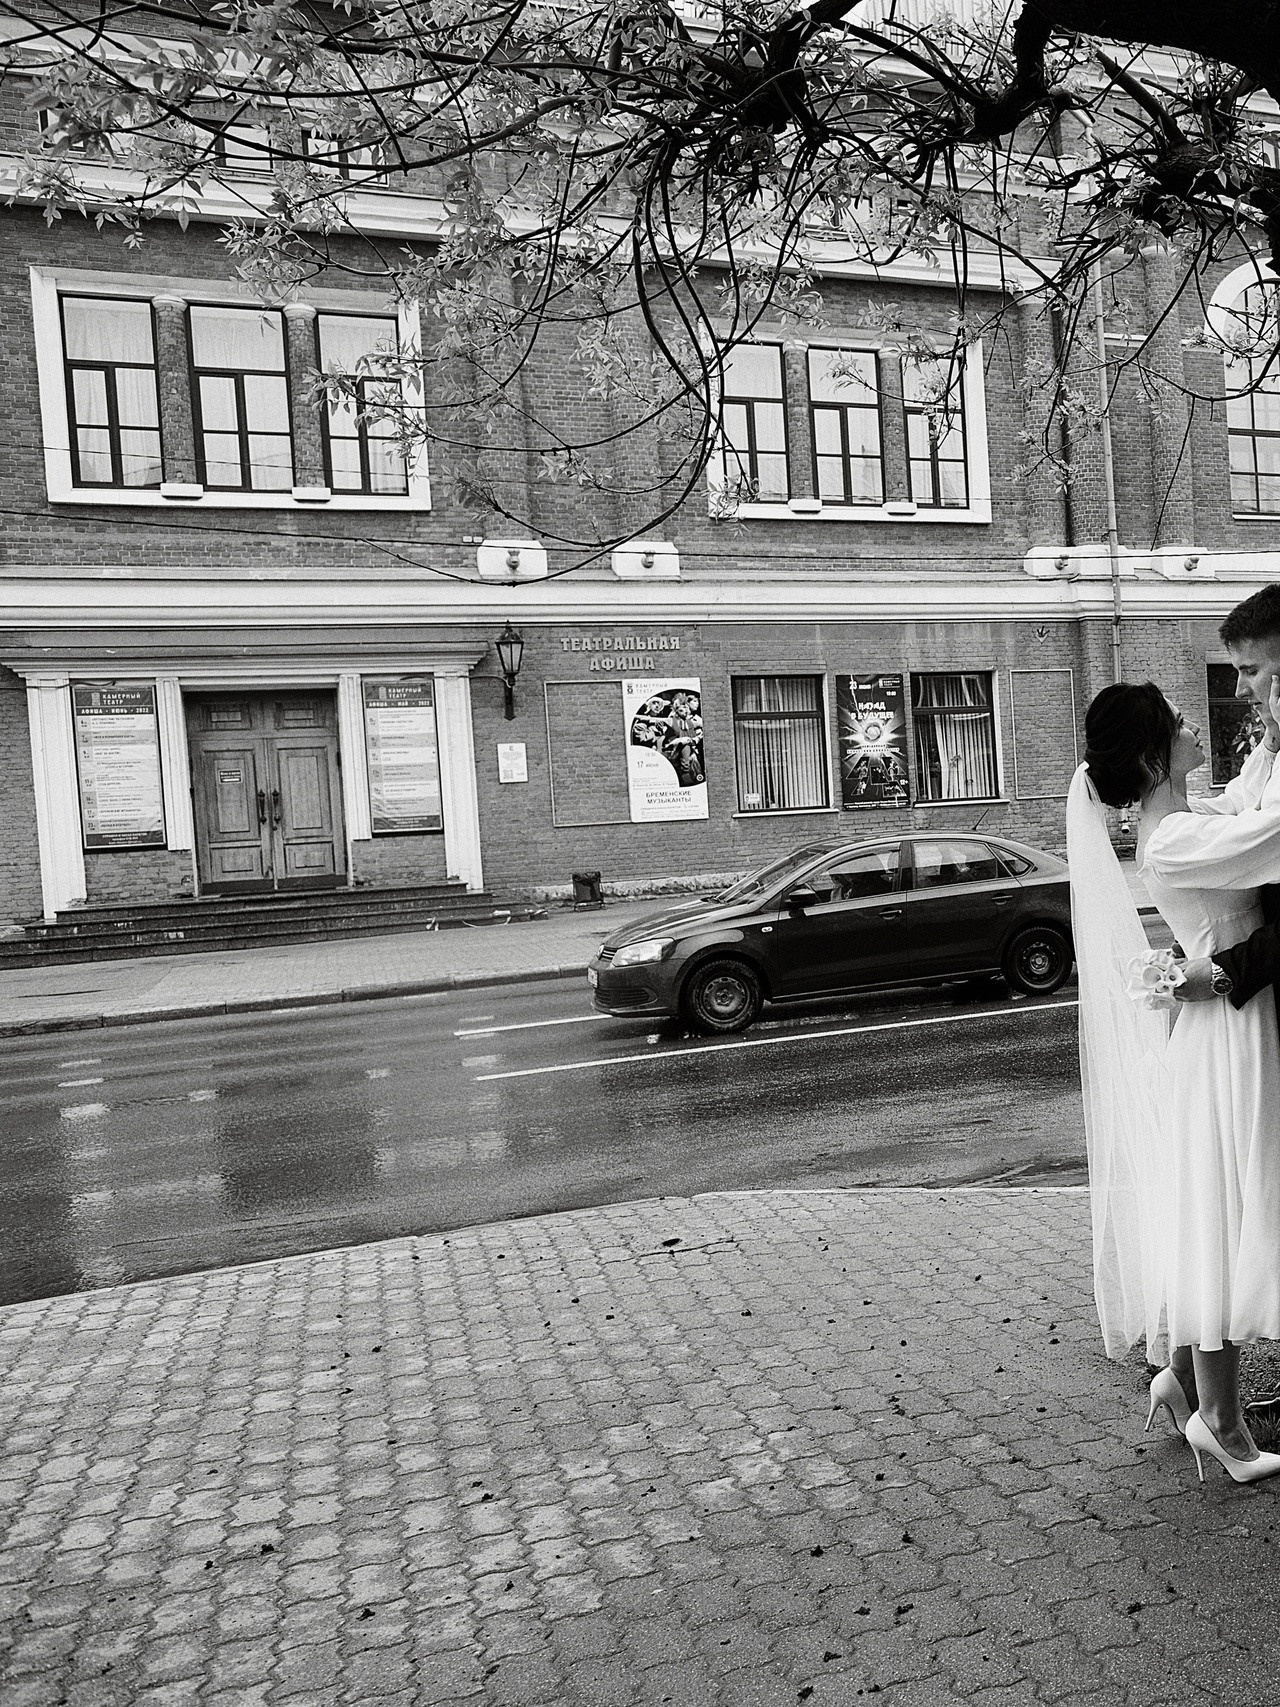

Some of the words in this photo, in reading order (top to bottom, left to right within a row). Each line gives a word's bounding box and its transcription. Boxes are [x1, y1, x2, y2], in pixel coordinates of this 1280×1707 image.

[560, 636, 681, 651] ТЕАТРАЛЬНАЯ
[589, 656, 656, 671] АФИША
[645, 790, 692, 798] БРЕМЕНСКИЕ
